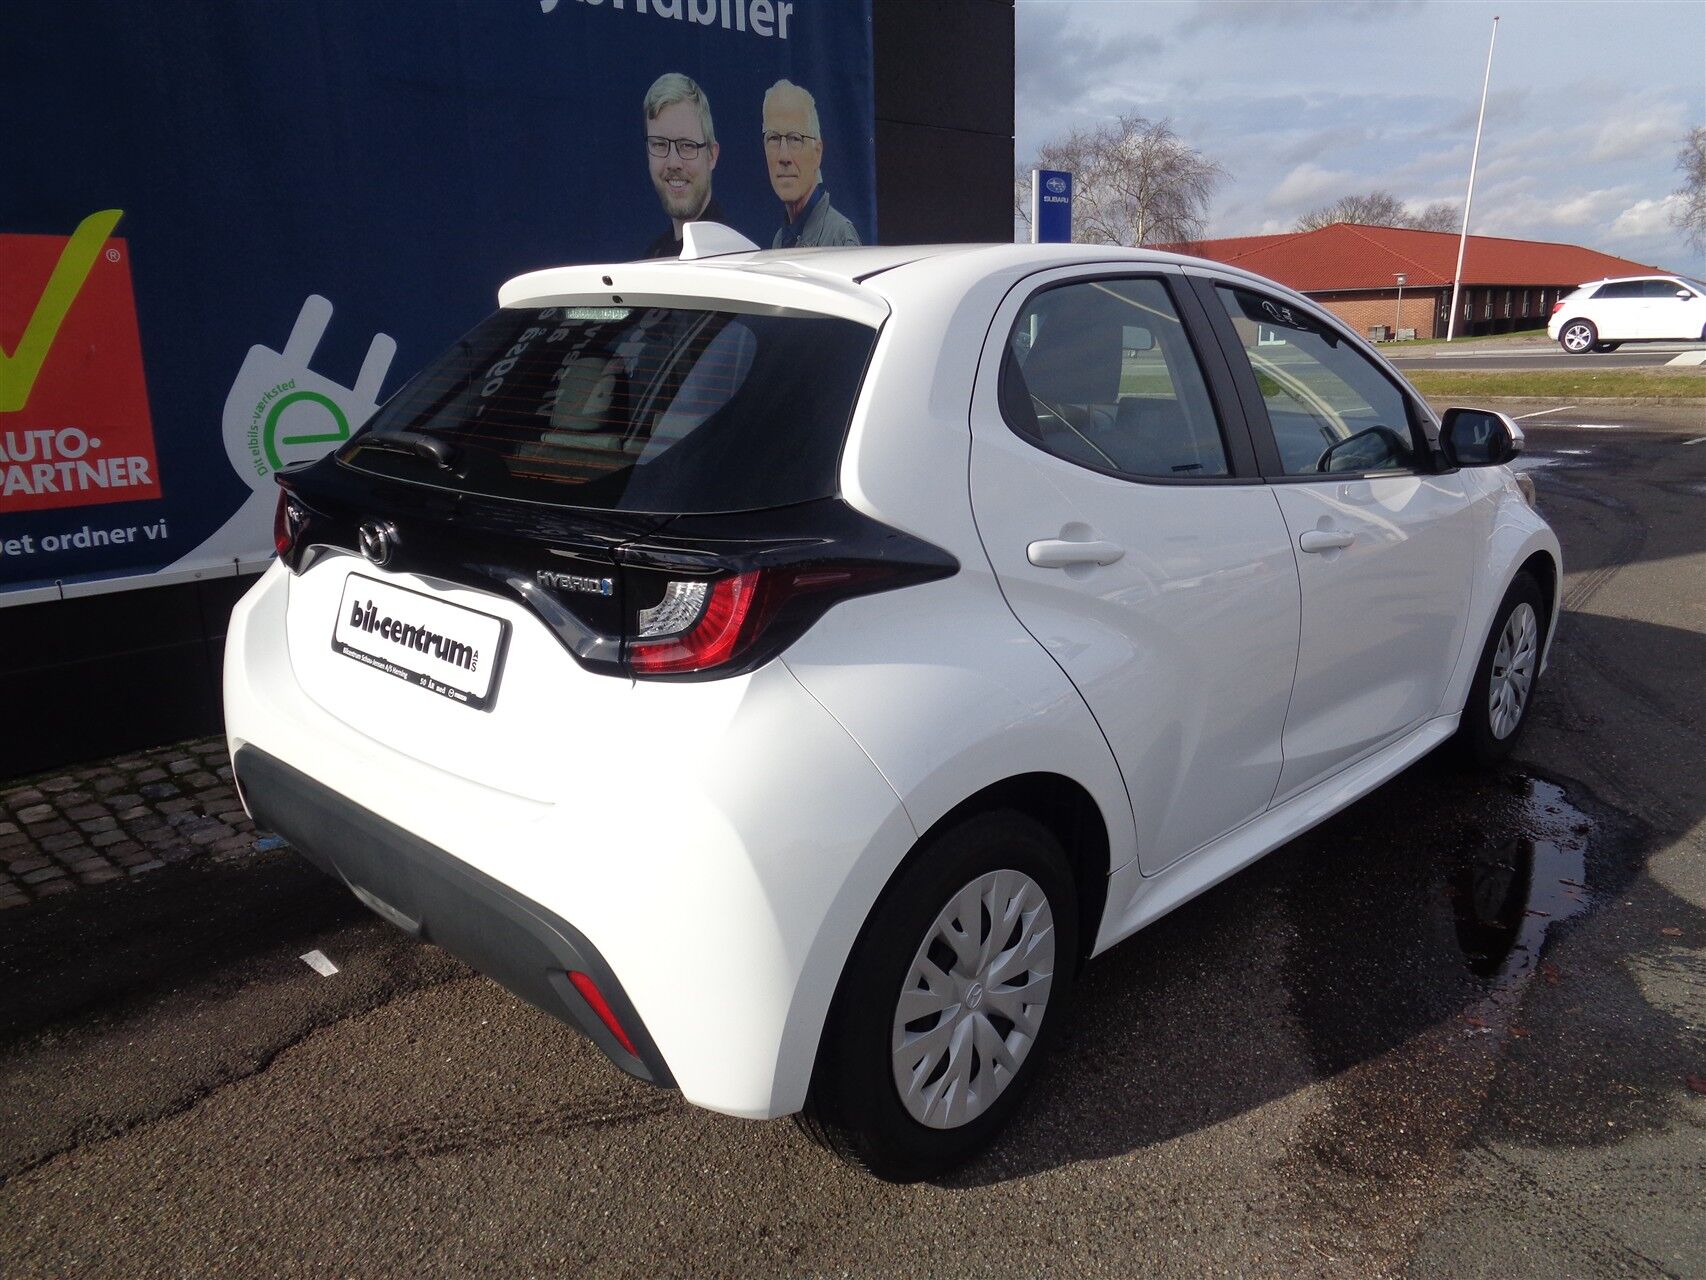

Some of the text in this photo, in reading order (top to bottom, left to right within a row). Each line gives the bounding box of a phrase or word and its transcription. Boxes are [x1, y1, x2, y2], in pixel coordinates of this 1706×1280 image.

[1044, 196, 1069, 204] SUBARU
[0, 456, 153, 497] ARTNER
[253, 458, 268, 476] Dit
[0, 518, 168, 556] et ordner vi
